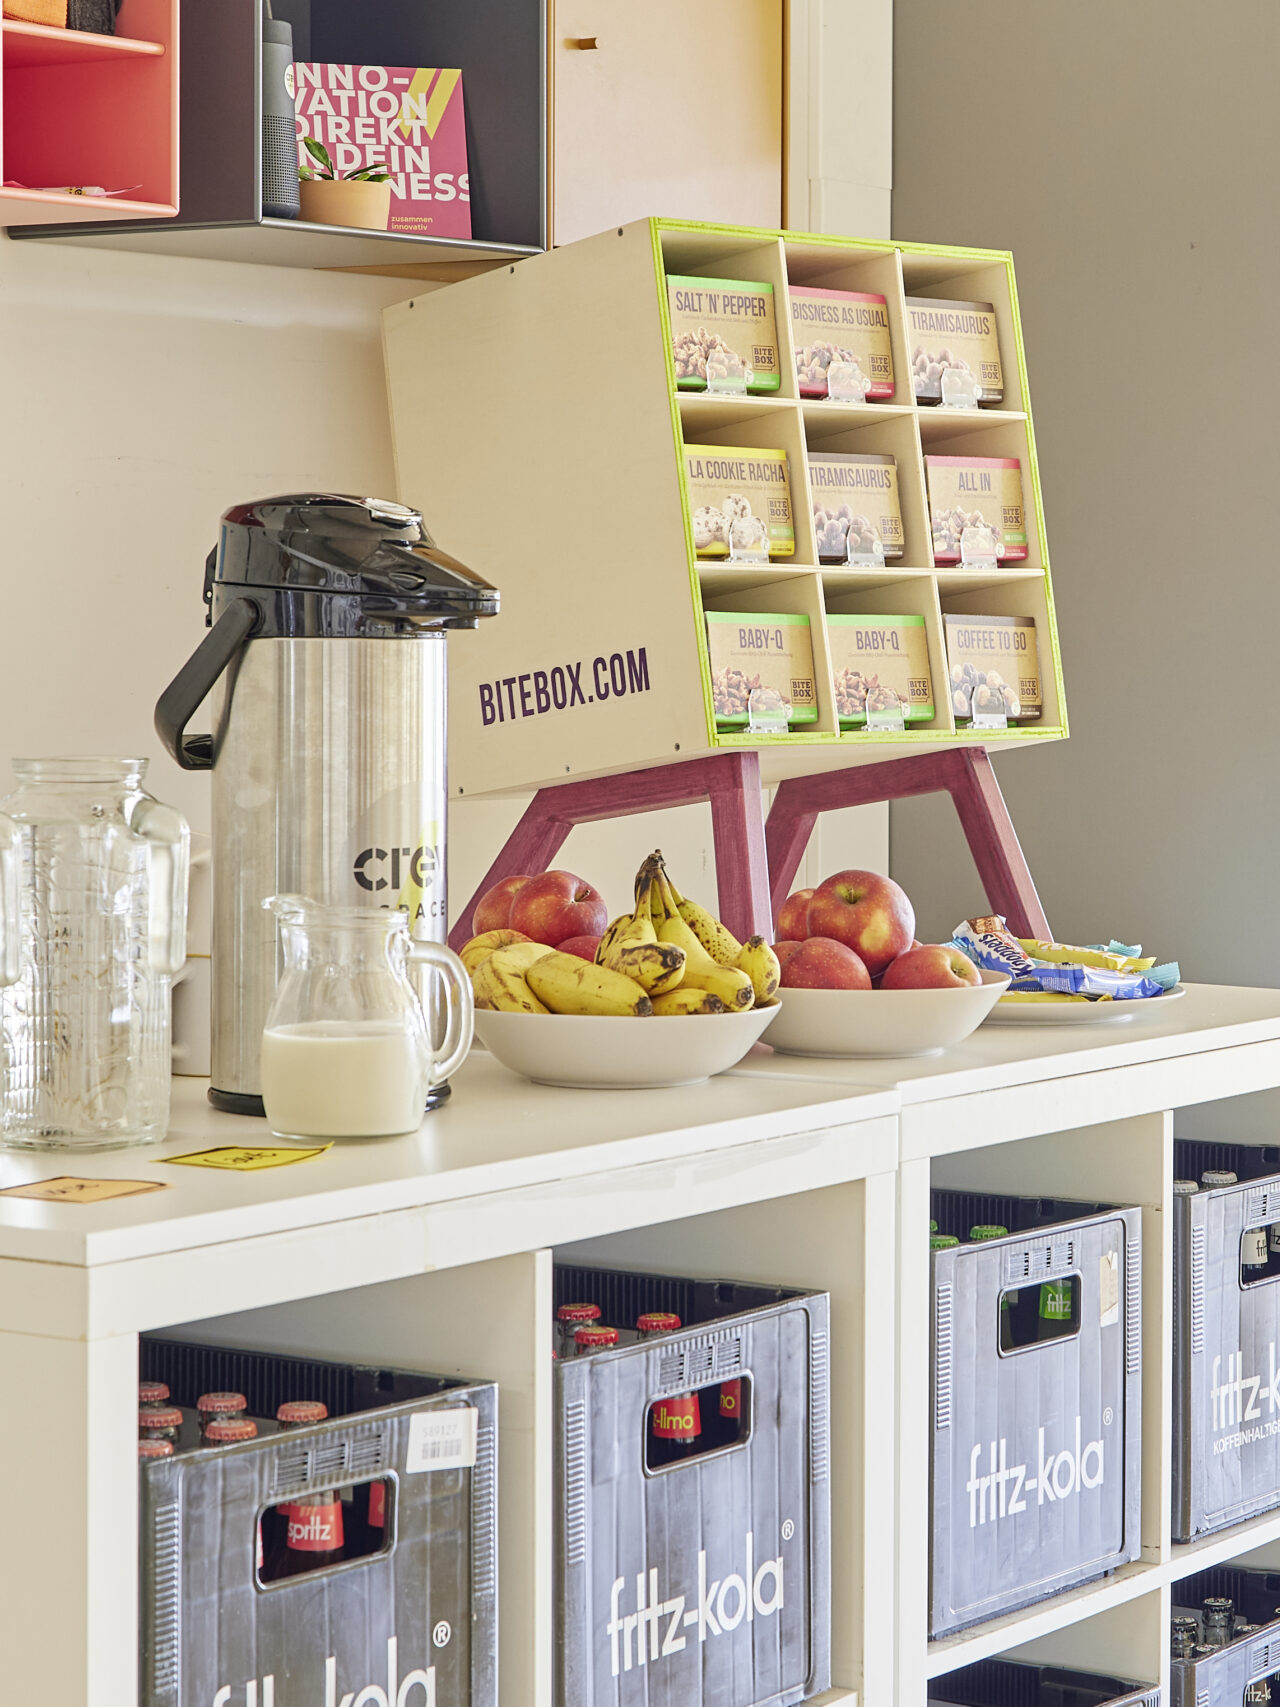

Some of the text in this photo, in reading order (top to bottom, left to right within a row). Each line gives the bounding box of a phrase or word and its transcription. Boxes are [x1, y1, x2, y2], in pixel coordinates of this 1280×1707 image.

[296, 62, 409, 92] NNO-
[335, 143, 431, 174] DEIN
[391, 223, 428, 231] innovativ
[675, 291, 767, 317] SALT 'N' PEPPER
[792, 303, 840, 324] BISSNESS
[841, 307, 855, 325] AS
[855, 308, 888, 328] USUAL
[910, 311, 990, 335] TIRAMISAURUS
[754, 347, 773, 356] BITE
[754, 355, 774, 365] BOX
[871, 356, 888, 364] BITE
[871, 364, 889, 373] BOX
[981, 363, 998, 372] BITE
[982, 371, 999, 380] BOX
[689, 459, 786, 482] LA COOKIE RACHA
[808, 466, 892, 489] TIRAMISAURUS
[958, 472, 991, 491] ALL IN
[769, 500, 787, 508] BITE
[769, 508, 788, 517] BOX
[1002, 508, 1020, 516] BITE
[1003, 515, 1021, 524] BOX
[882, 526, 900, 535] BOX
[739, 628, 784, 650] BABY-Q
[855, 630, 900, 651] BABY-Q
[957, 629, 1027, 651] COFFEE TO GO
[479, 647, 650, 726] BITEBOX.COM
[792, 681, 811, 689] BITE
[909, 680, 927, 688] BITE
[792, 689, 811, 697] BOX
[910, 688, 928, 696] BOX
[1020, 687, 1037, 696] BOX
[353, 845, 440, 892] cre
[978, 933, 1032, 978] Knoppers
[965, 1415, 1104, 1528] fritz-kola
[288, 1515, 331, 1544] spritz
[606, 1531, 783, 1677] fritz-kola
